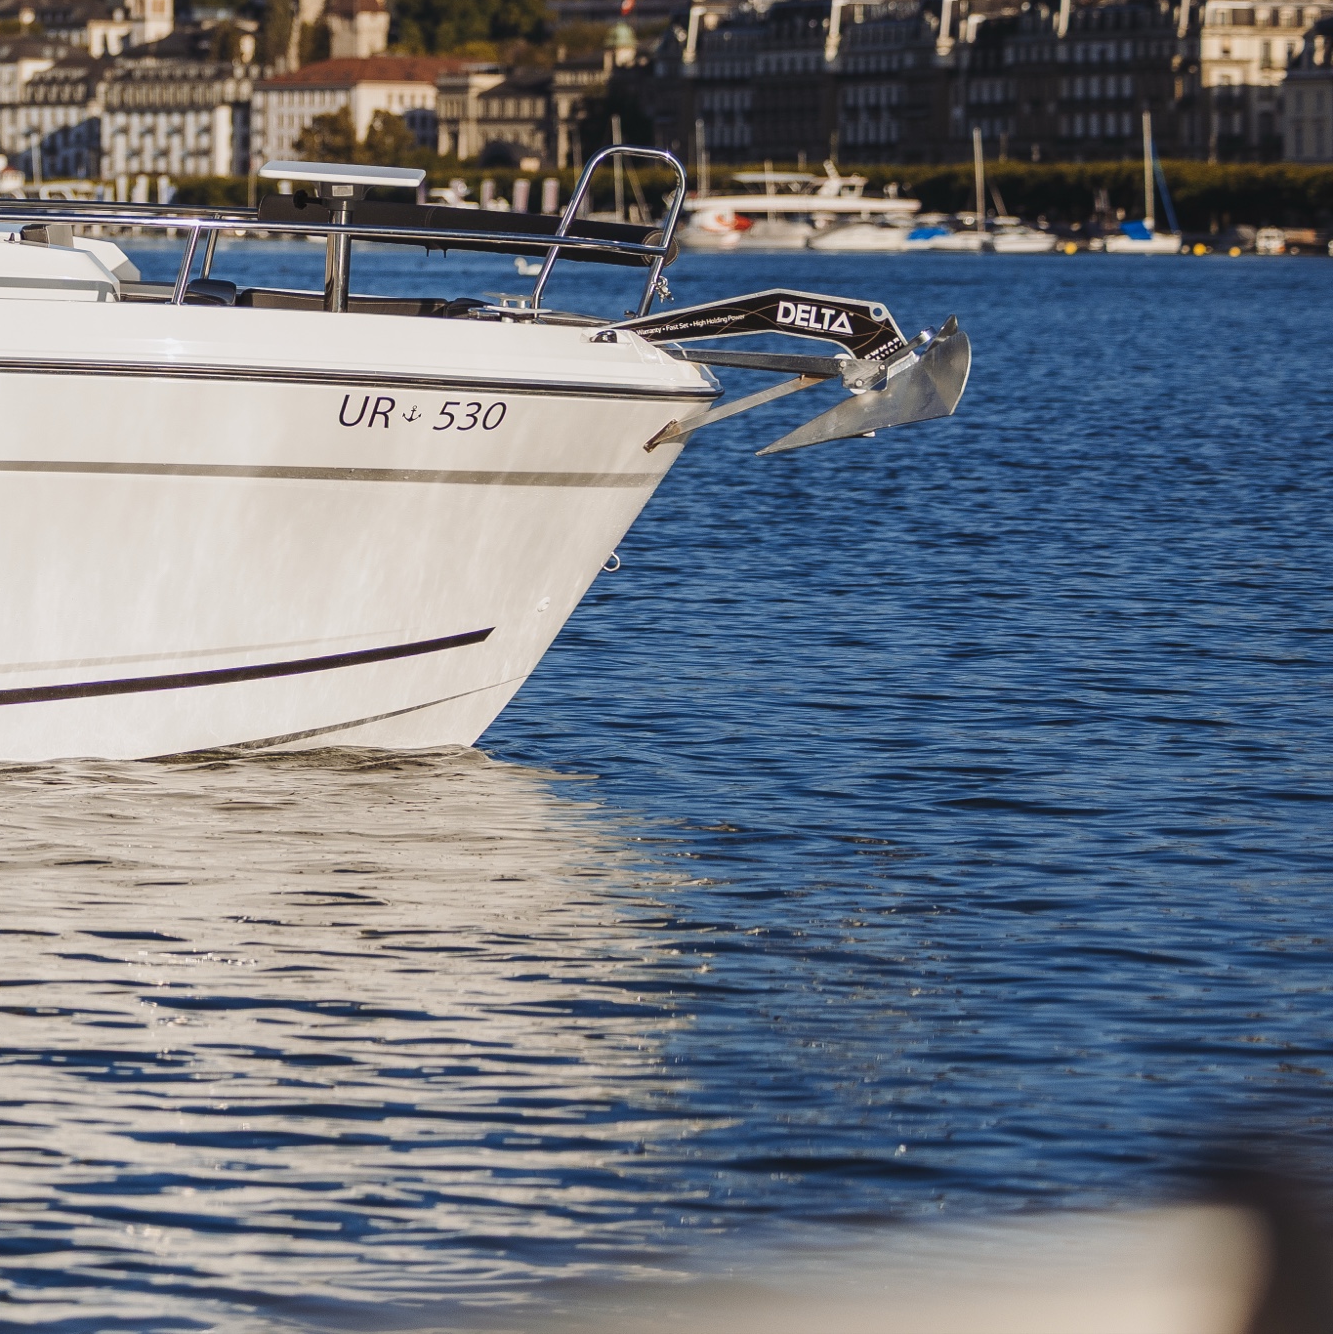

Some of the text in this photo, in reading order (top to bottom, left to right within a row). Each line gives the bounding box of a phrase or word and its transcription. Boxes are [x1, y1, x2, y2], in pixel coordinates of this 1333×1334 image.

[693, 319, 706, 327] High
[706, 314, 728, 324] Holding
[728, 314, 745, 322] Power
[776, 301, 853, 334] DELTA
[338, 394, 507, 431] UR 530
